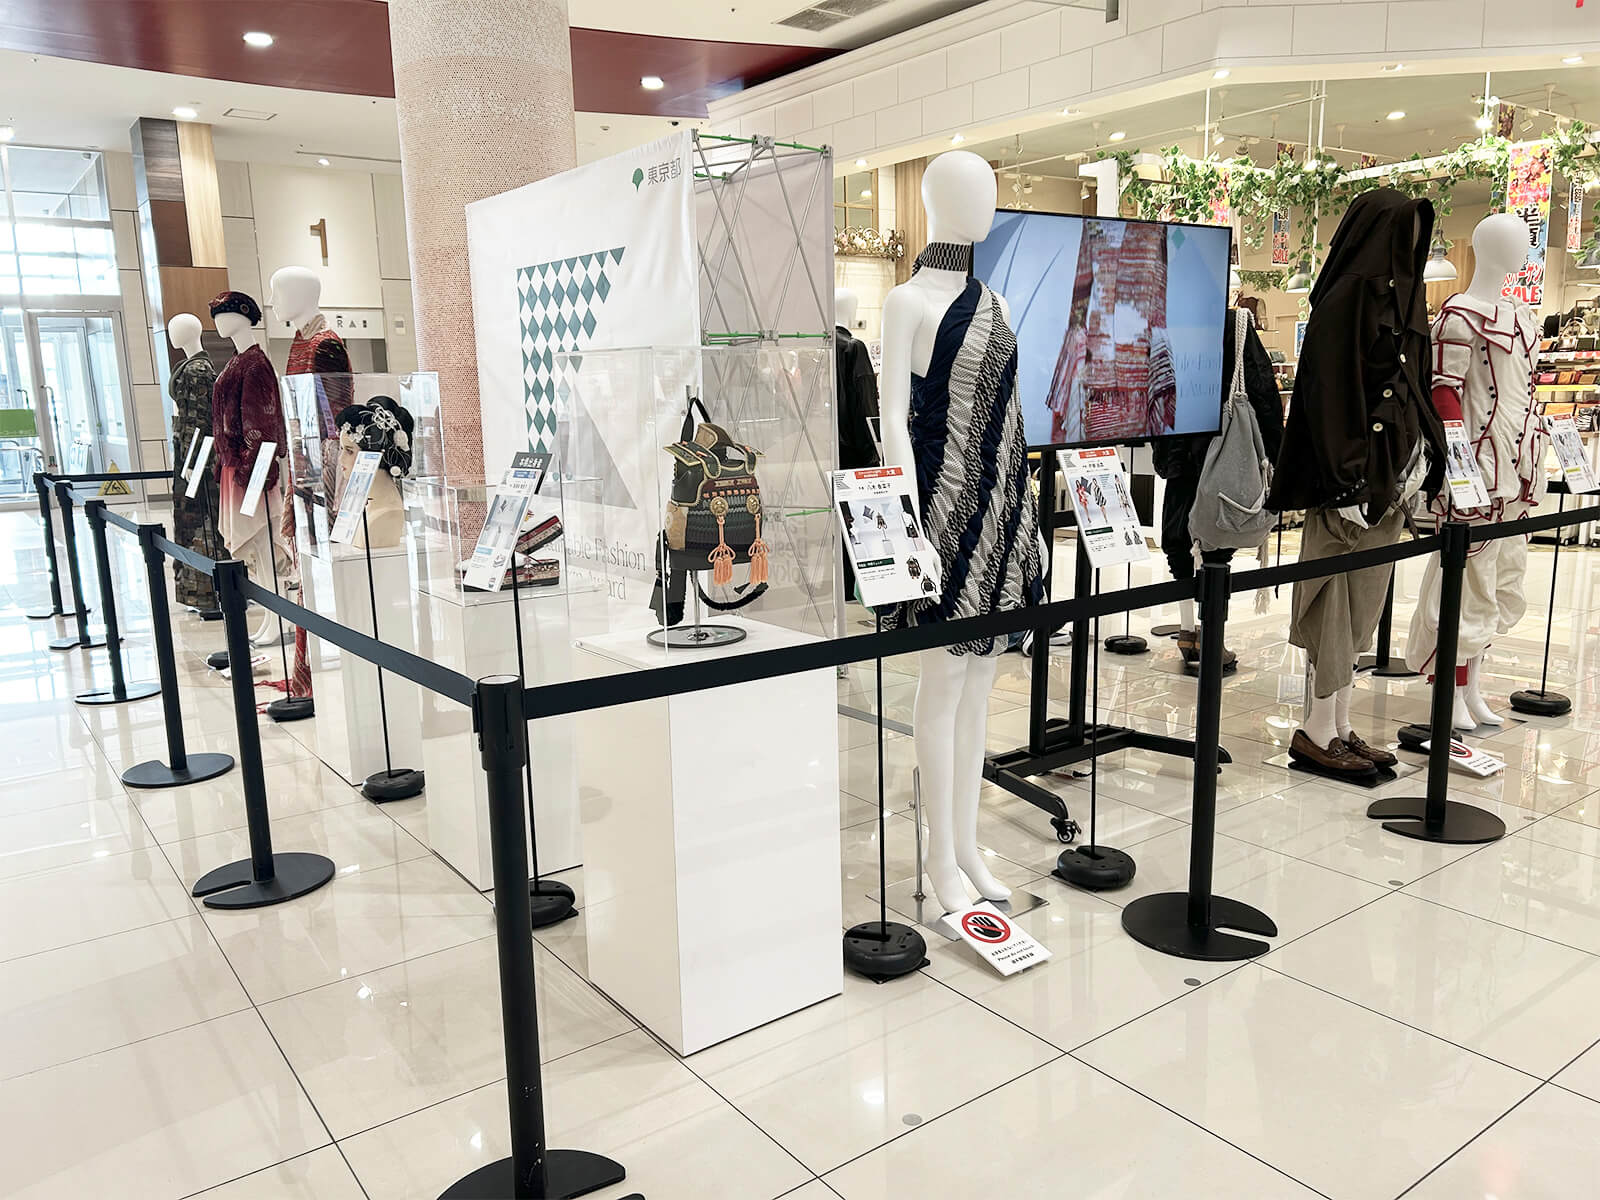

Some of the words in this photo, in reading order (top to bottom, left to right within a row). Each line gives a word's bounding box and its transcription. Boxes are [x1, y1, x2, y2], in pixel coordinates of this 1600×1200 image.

[647, 157, 682, 185] 東京都
[309, 218, 328, 259] 1
[594, 537, 646, 572] Fashion
